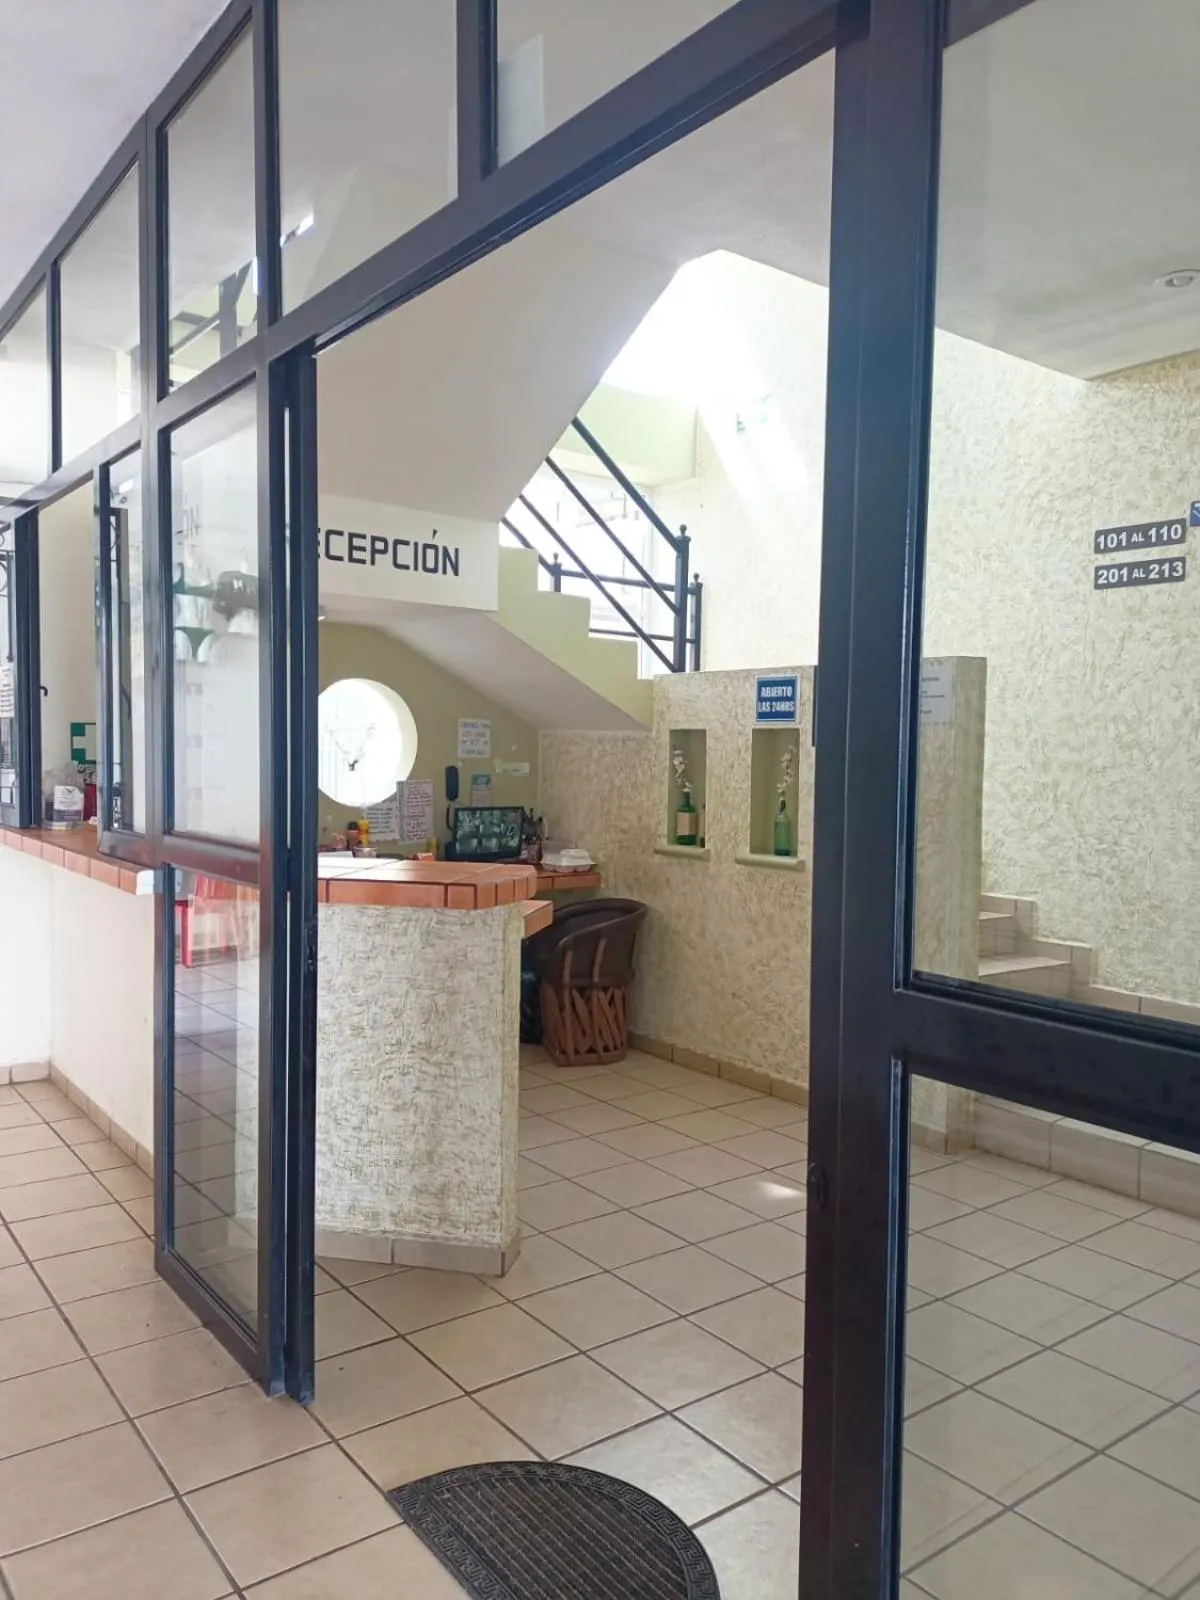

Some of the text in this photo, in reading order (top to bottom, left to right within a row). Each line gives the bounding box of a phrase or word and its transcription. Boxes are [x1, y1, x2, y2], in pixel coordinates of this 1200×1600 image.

[1097, 524, 1182, 550] 101 AL 110
[318, 528, 460, 577] CEPCIÓN
[1097, 561, 1183, 584] 201 AL 213
[760, 686, 793, 698] ABIERTO
[758, 702, 771, 712] LAS
